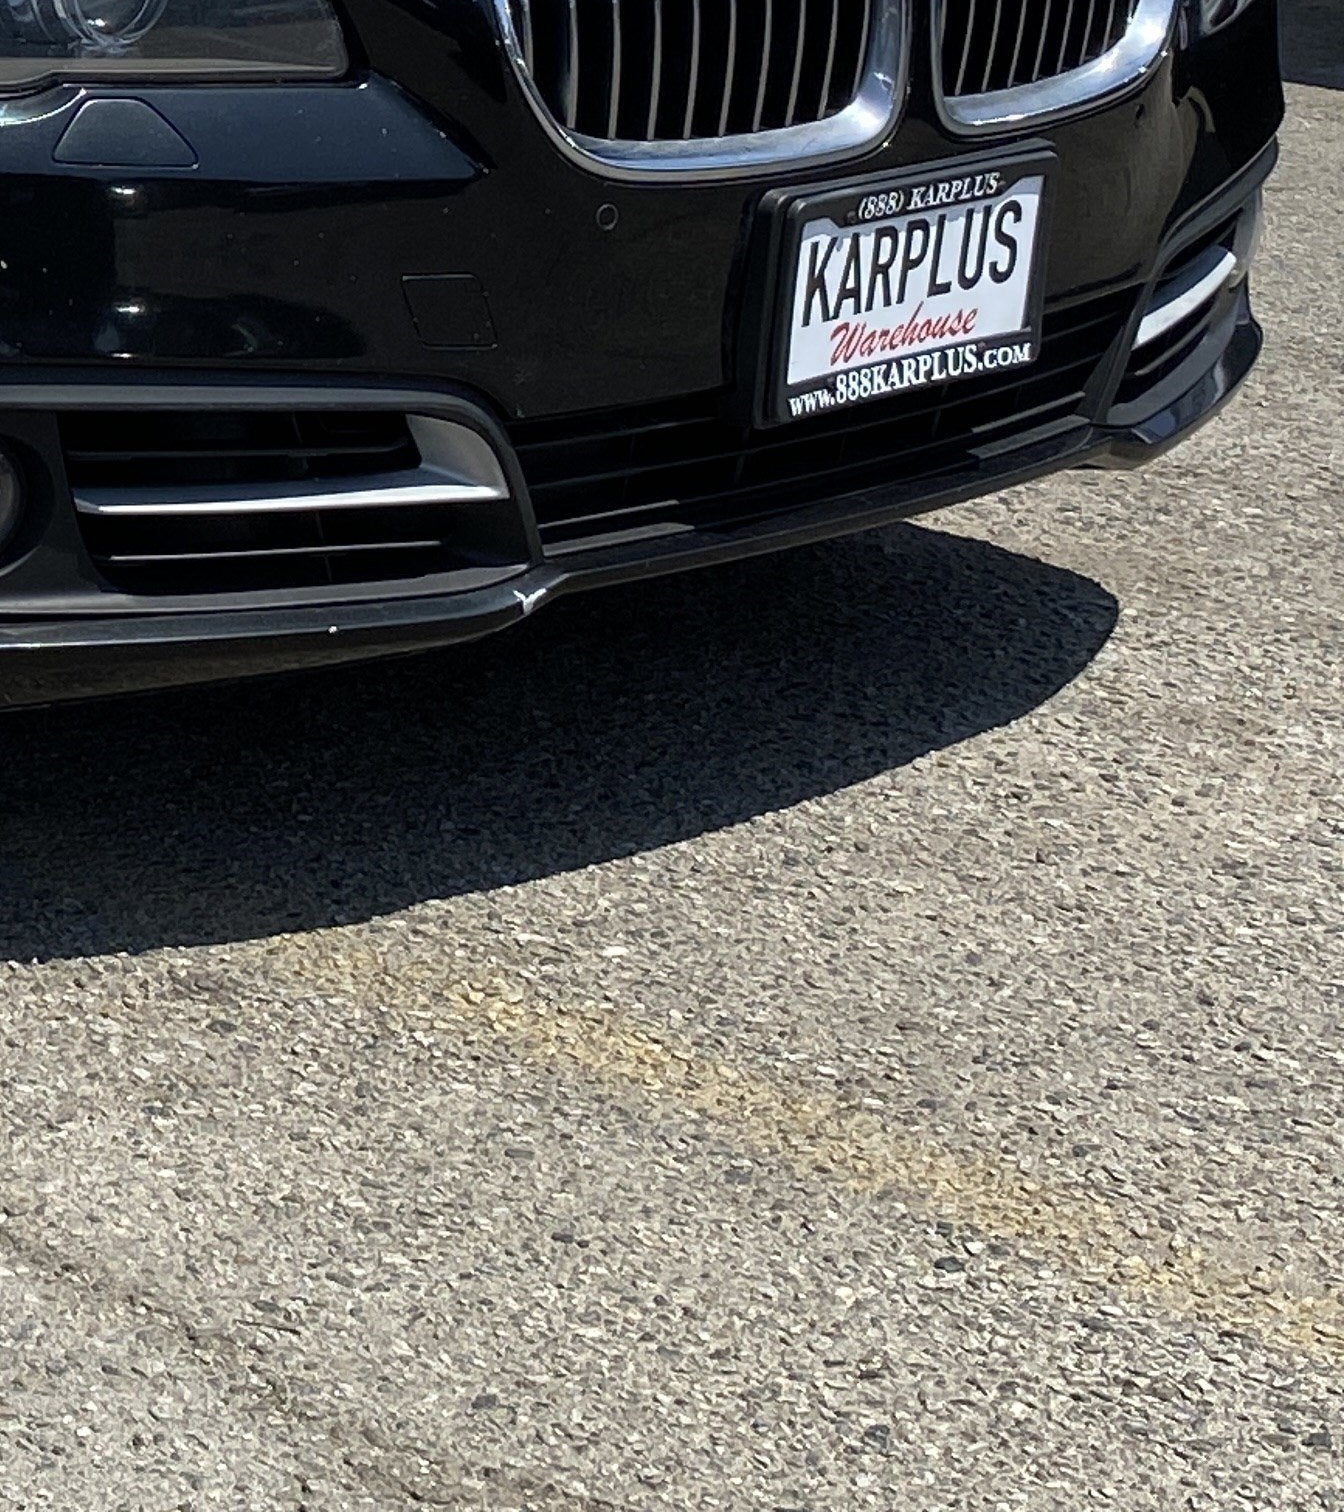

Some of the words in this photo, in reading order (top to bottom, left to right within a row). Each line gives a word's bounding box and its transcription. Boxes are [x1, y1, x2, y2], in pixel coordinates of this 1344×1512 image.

[858, 190, 905, 221] (888)
[906, 171, 1001, 211] KARPLUS
[801, 199, 1022, 327] KARPLUS
[830, 300, 978, 367] Warehouse
